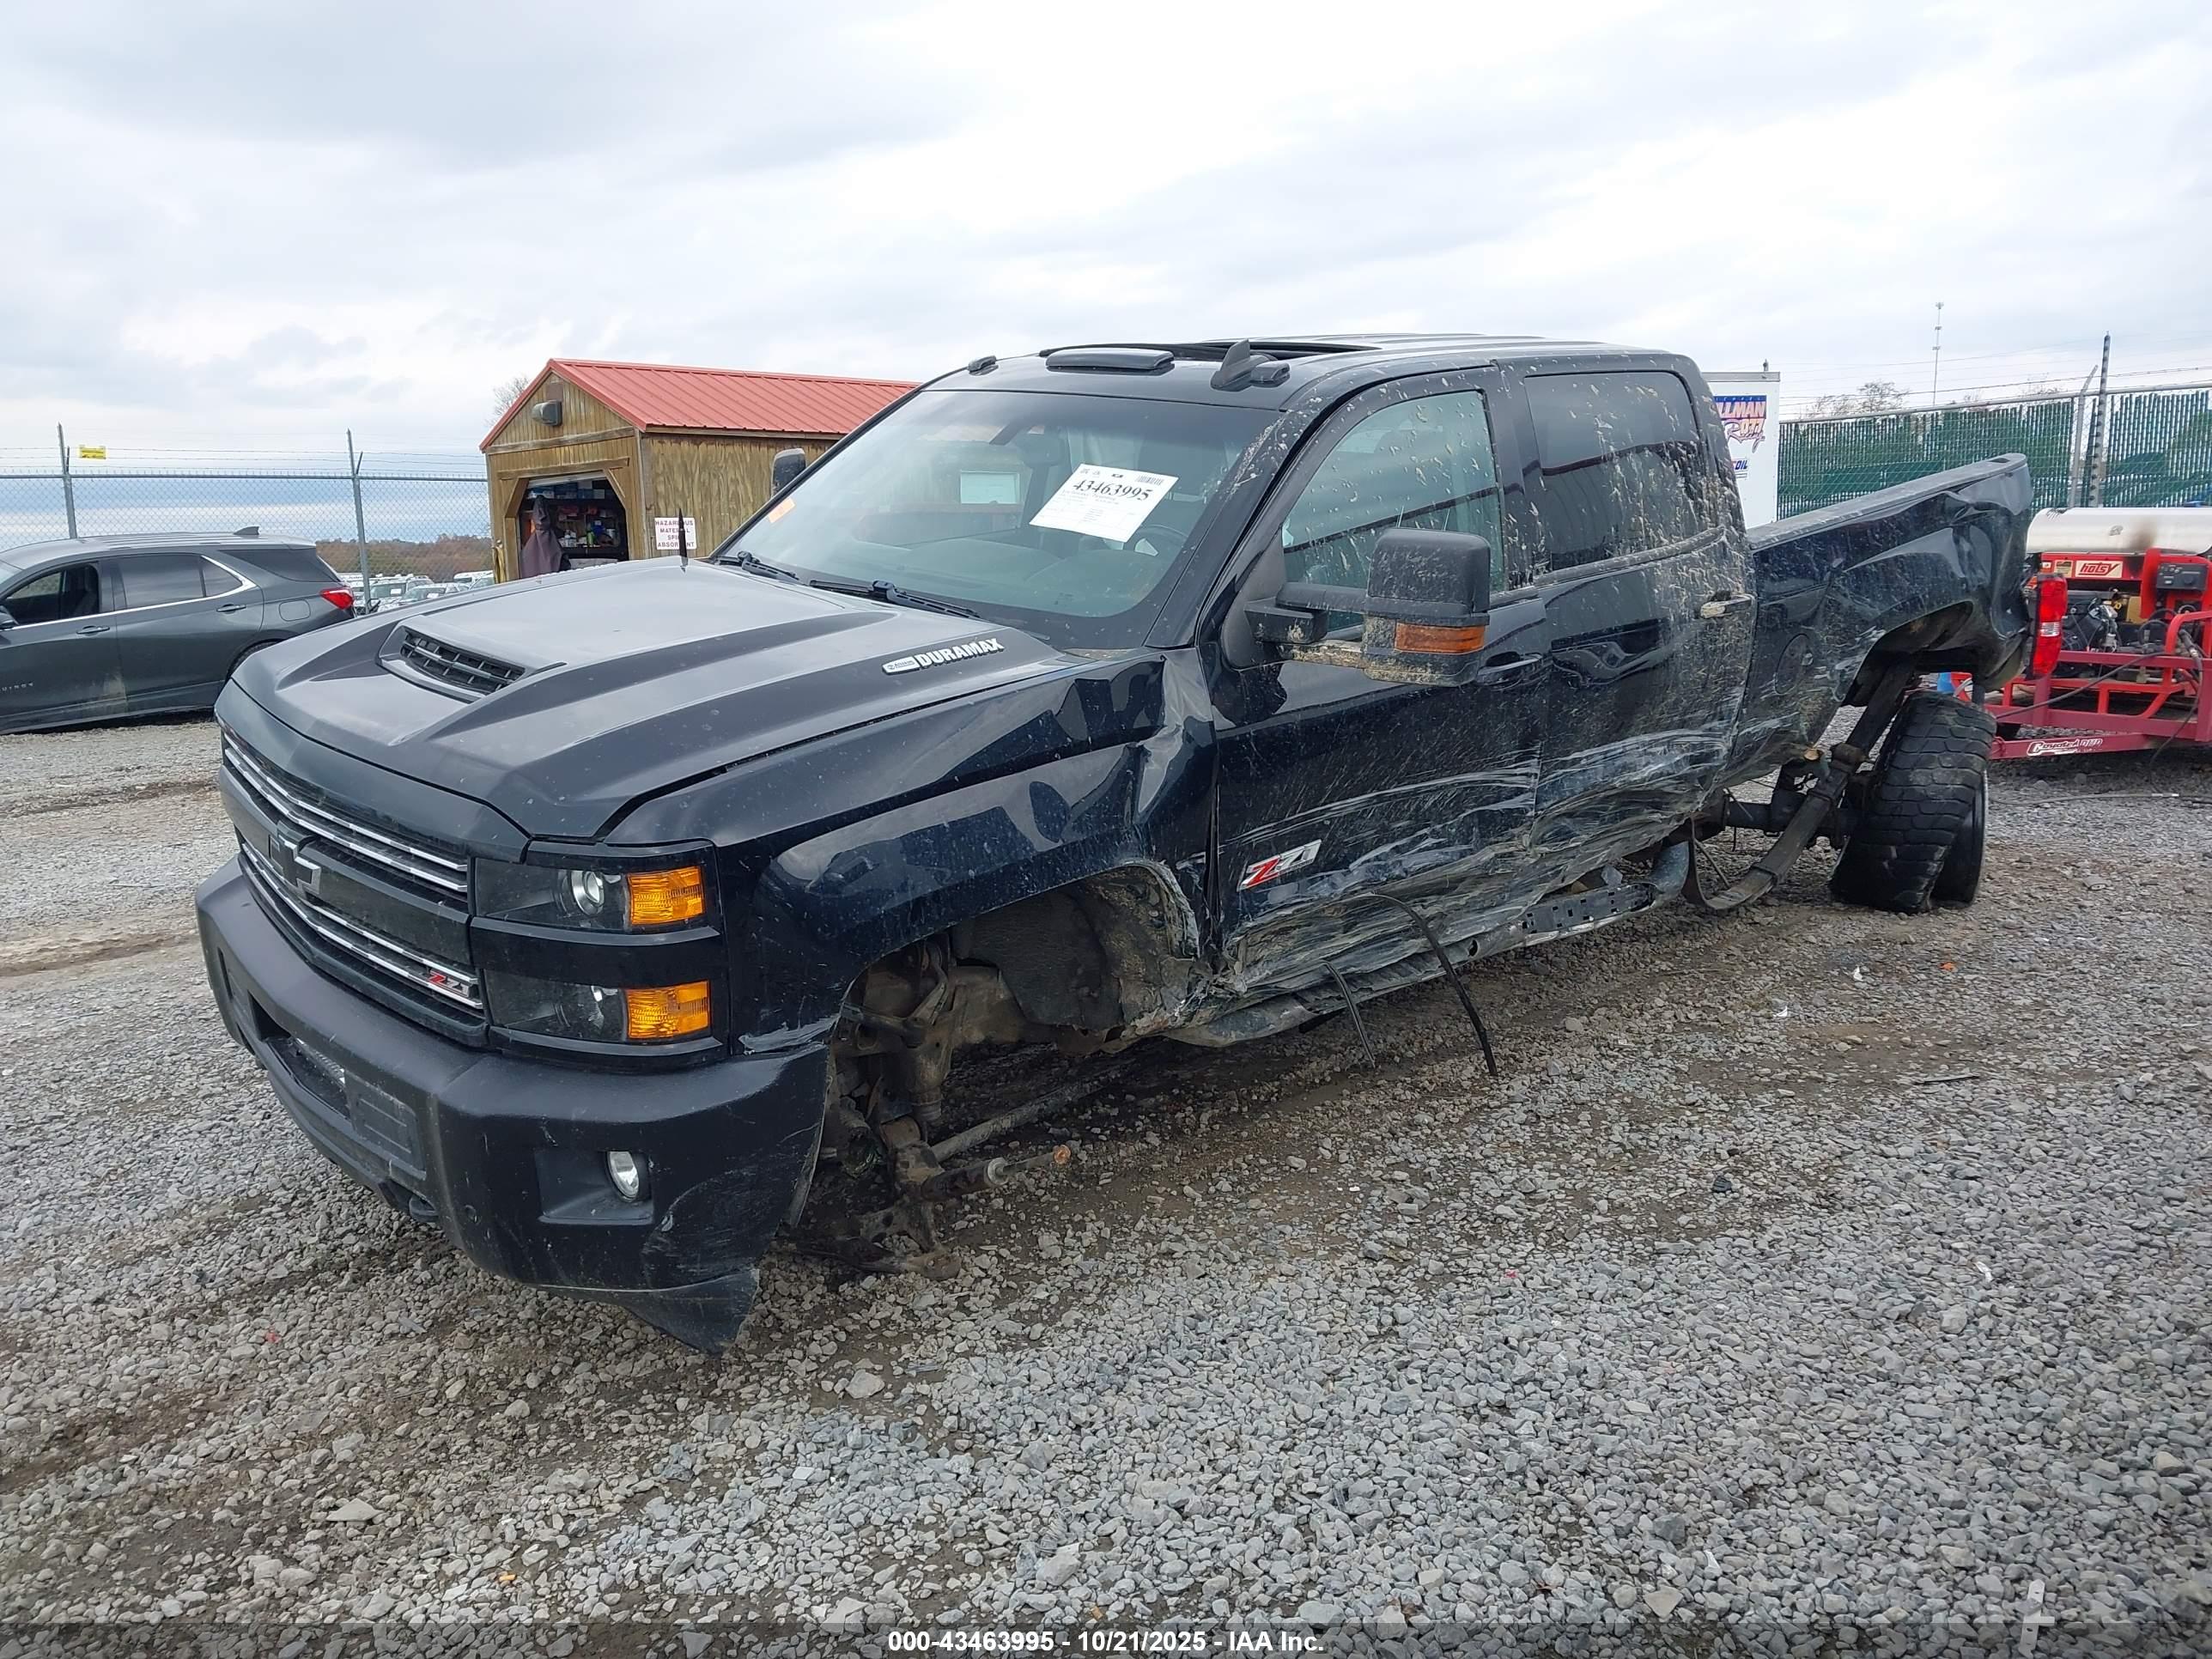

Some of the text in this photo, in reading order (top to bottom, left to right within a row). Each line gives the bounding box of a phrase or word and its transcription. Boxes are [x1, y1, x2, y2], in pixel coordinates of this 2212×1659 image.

[1073, 479, 1152, 501] 43463995
[914, 638, 1005, 667] DURAMAX
[1239, 838, 1322, 890] Z71
[428, 970, 470, 998] Z71
